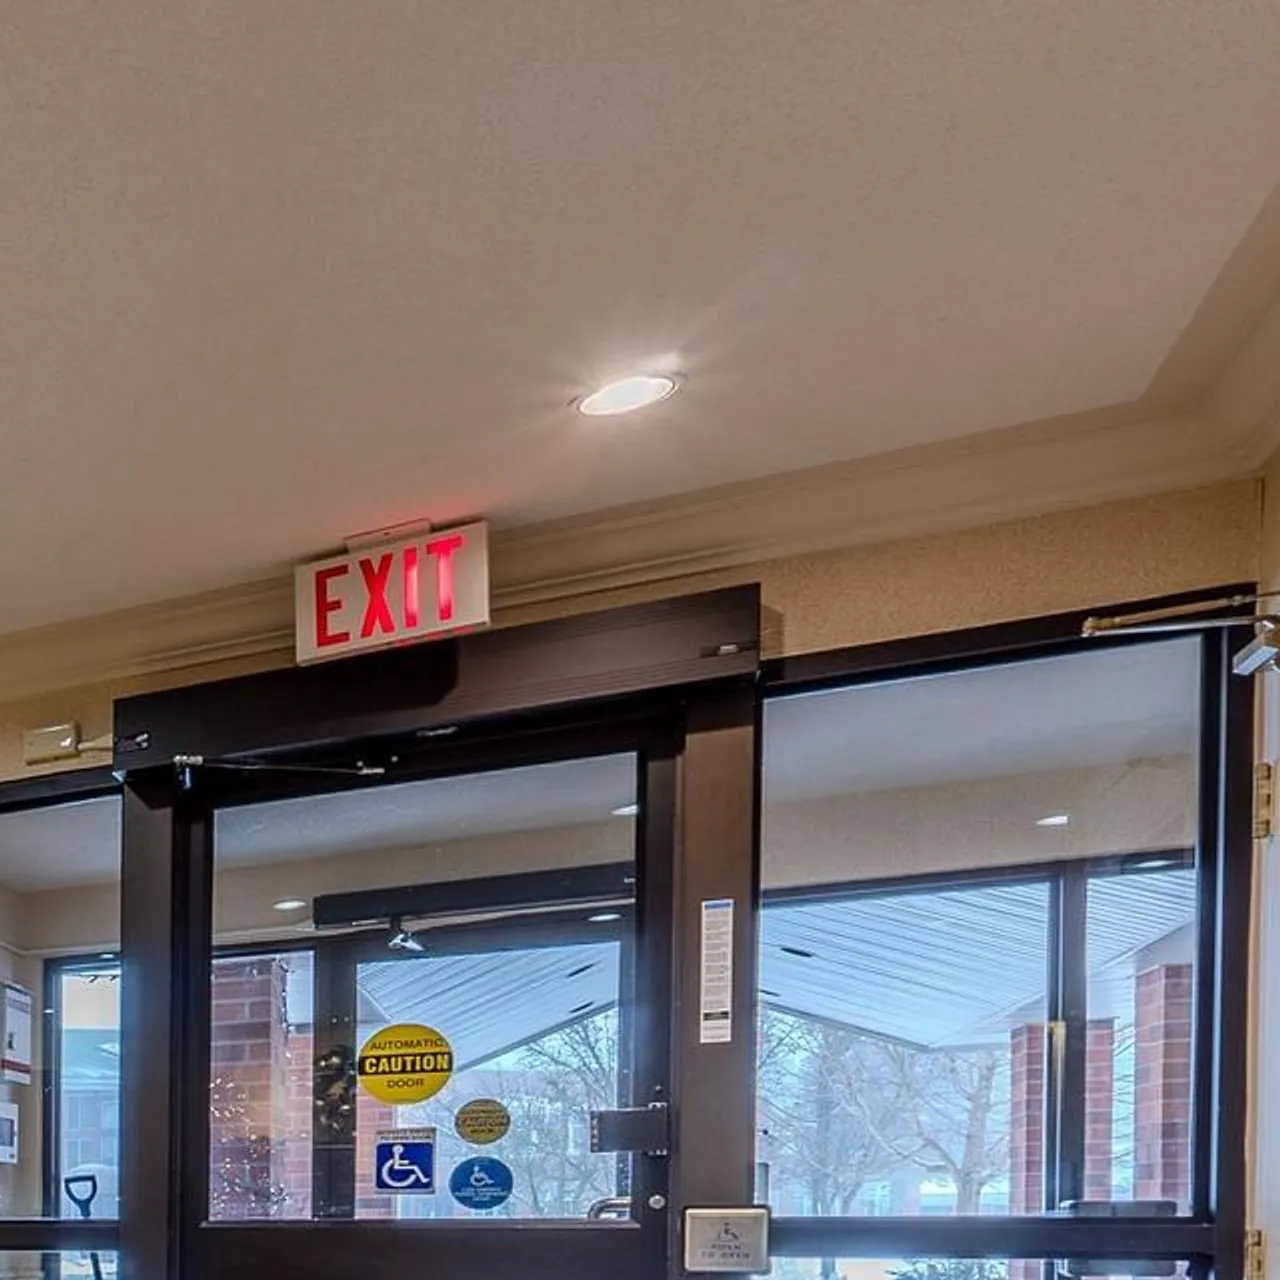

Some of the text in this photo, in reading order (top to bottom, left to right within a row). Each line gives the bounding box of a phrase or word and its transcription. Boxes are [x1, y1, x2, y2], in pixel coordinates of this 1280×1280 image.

[315, 536, 462, 647] EXIT
[370, 1038, 443, 1050] AUTOMATIC
[365, 1054, 449, 1073] CAUTION
[387, 1078, 424, 1089] DOOR
